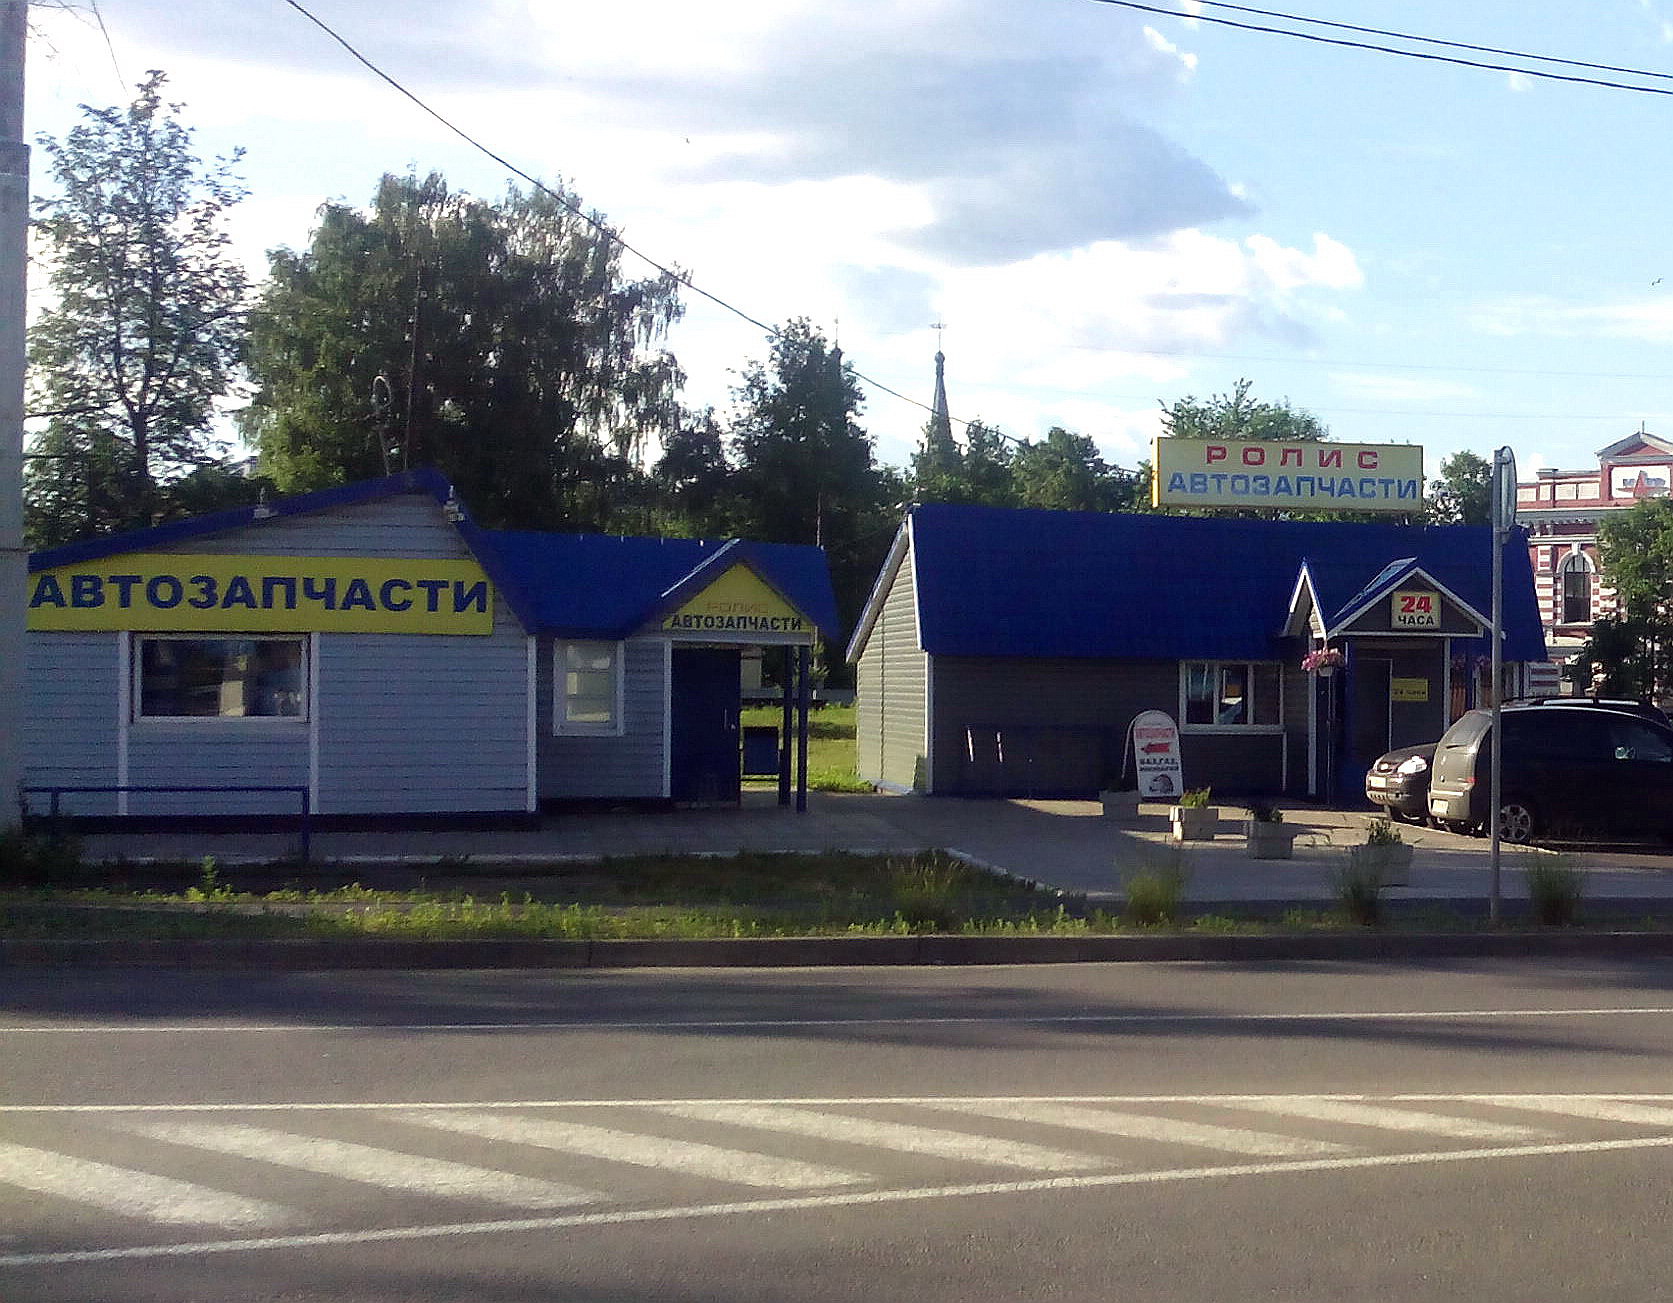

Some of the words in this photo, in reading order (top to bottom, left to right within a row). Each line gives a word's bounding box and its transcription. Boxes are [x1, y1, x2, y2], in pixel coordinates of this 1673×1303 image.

[1206, 445, 1379, 469] РОЛИС
[1167, 472, 1417, 499] АВТОЗАПЧАСТИ
[28, 573, 488, 613] АВТОЗАПЧАСТИ
[1400, 595, 1432, 613] 24
[671, 614, 802, 631] АВТОЗАПЧАСТИ
[1398, 615, 1434, 625] ЧАСА
